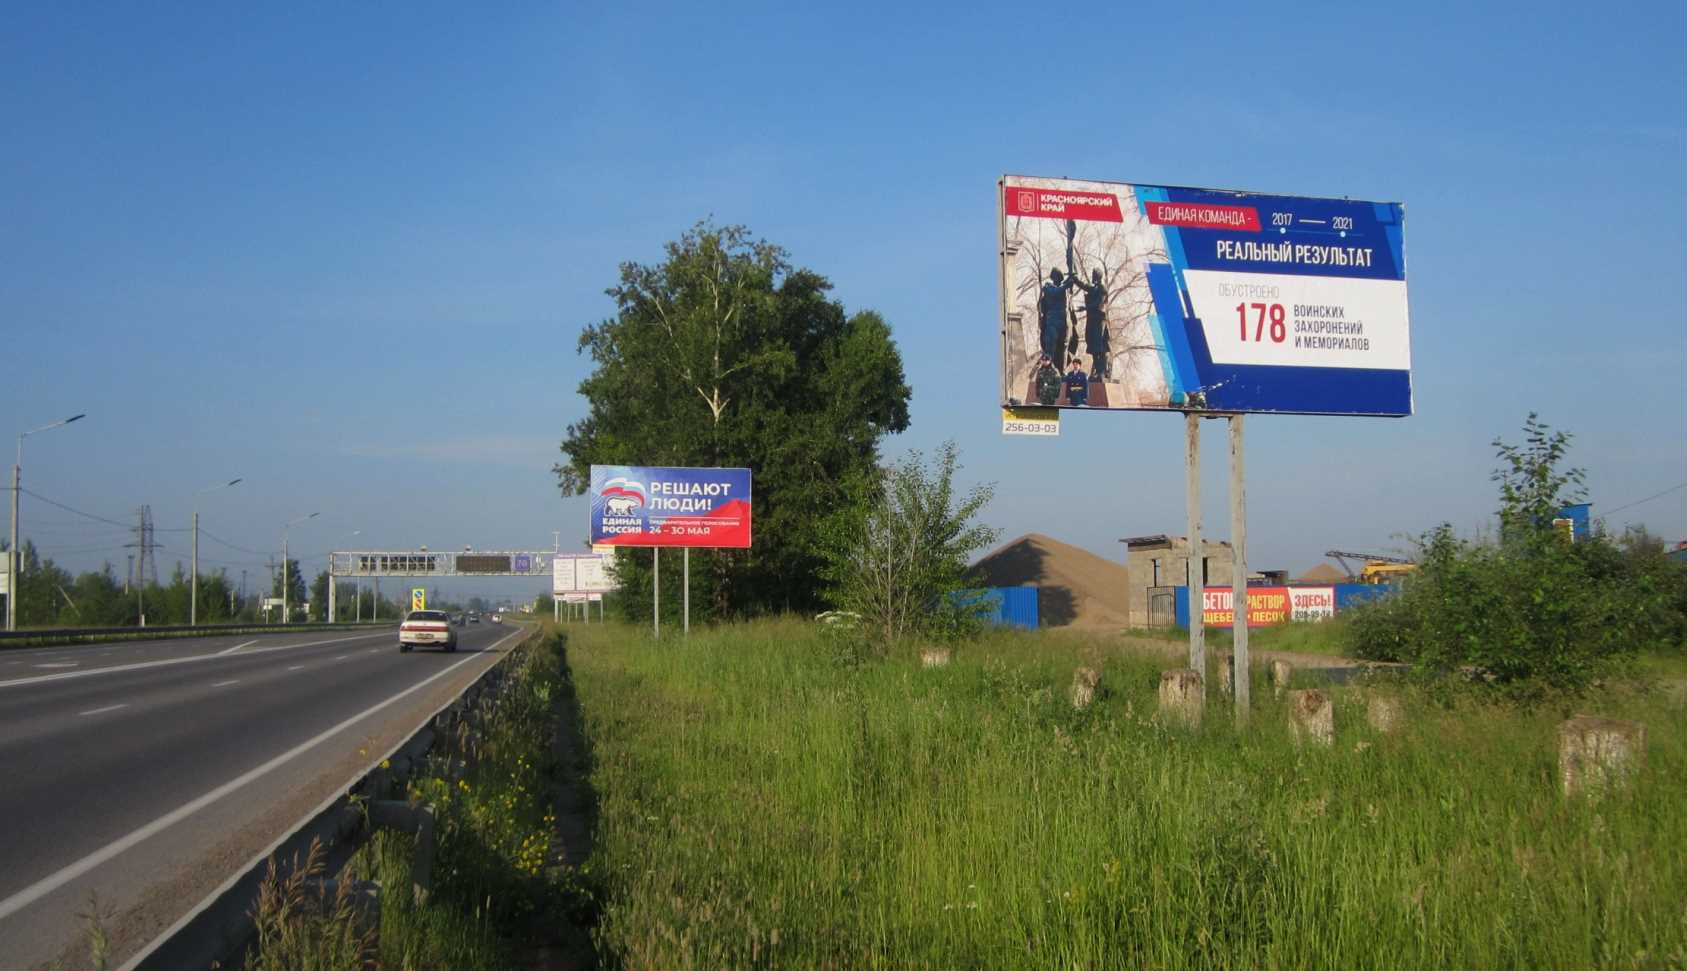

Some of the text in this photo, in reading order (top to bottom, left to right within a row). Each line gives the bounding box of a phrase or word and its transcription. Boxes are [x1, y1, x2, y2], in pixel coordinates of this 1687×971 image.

[1041, 194, 1112, 206] КРАСНОЯРСКИЙ
[1041, 203, 1065, 213] КРАЙ
[1158, 208, 1197, 222] ЕДИНАЯ
[1199, 209, 1246, 226] КОМАНДА
[1272, 213, 1353, 230] 2017 2021
[1217, 240, 1373, 267] РЕАЛЬНЫЙ РЕЗУЛЬТАТ
[1218, 283, 1279, 299] ОБУСТРОЕНО
[1294, 304, 1344, 318] ВОИНСКИХ
[1236, 302, 1286, 343] 178
[1294, 320, 1363, 335] ЗАХОРОНЕНИЙ
[1295, 336, 1370, 351] И МЕМОРИАЛОВ
[1005, 423, 1056, 433] 256-03-03
[650, 482, 732, 496] РЕШАЮТ
[649, 498, 712, 512] ЛЮДИ!
[602, 517, 642, 526] ЕДИНАЯ
[602, 526, 642, 534] РОССИЯ
[649, 526, 661, 534] 24
[671, 527, 685, 535] 30
[687, 527, 710, 536] МАЯ
[1294, 594, 1331, 608] ЗДЕСЬ!
[1203, 611, 1233, 624] ЩЕБЕ
